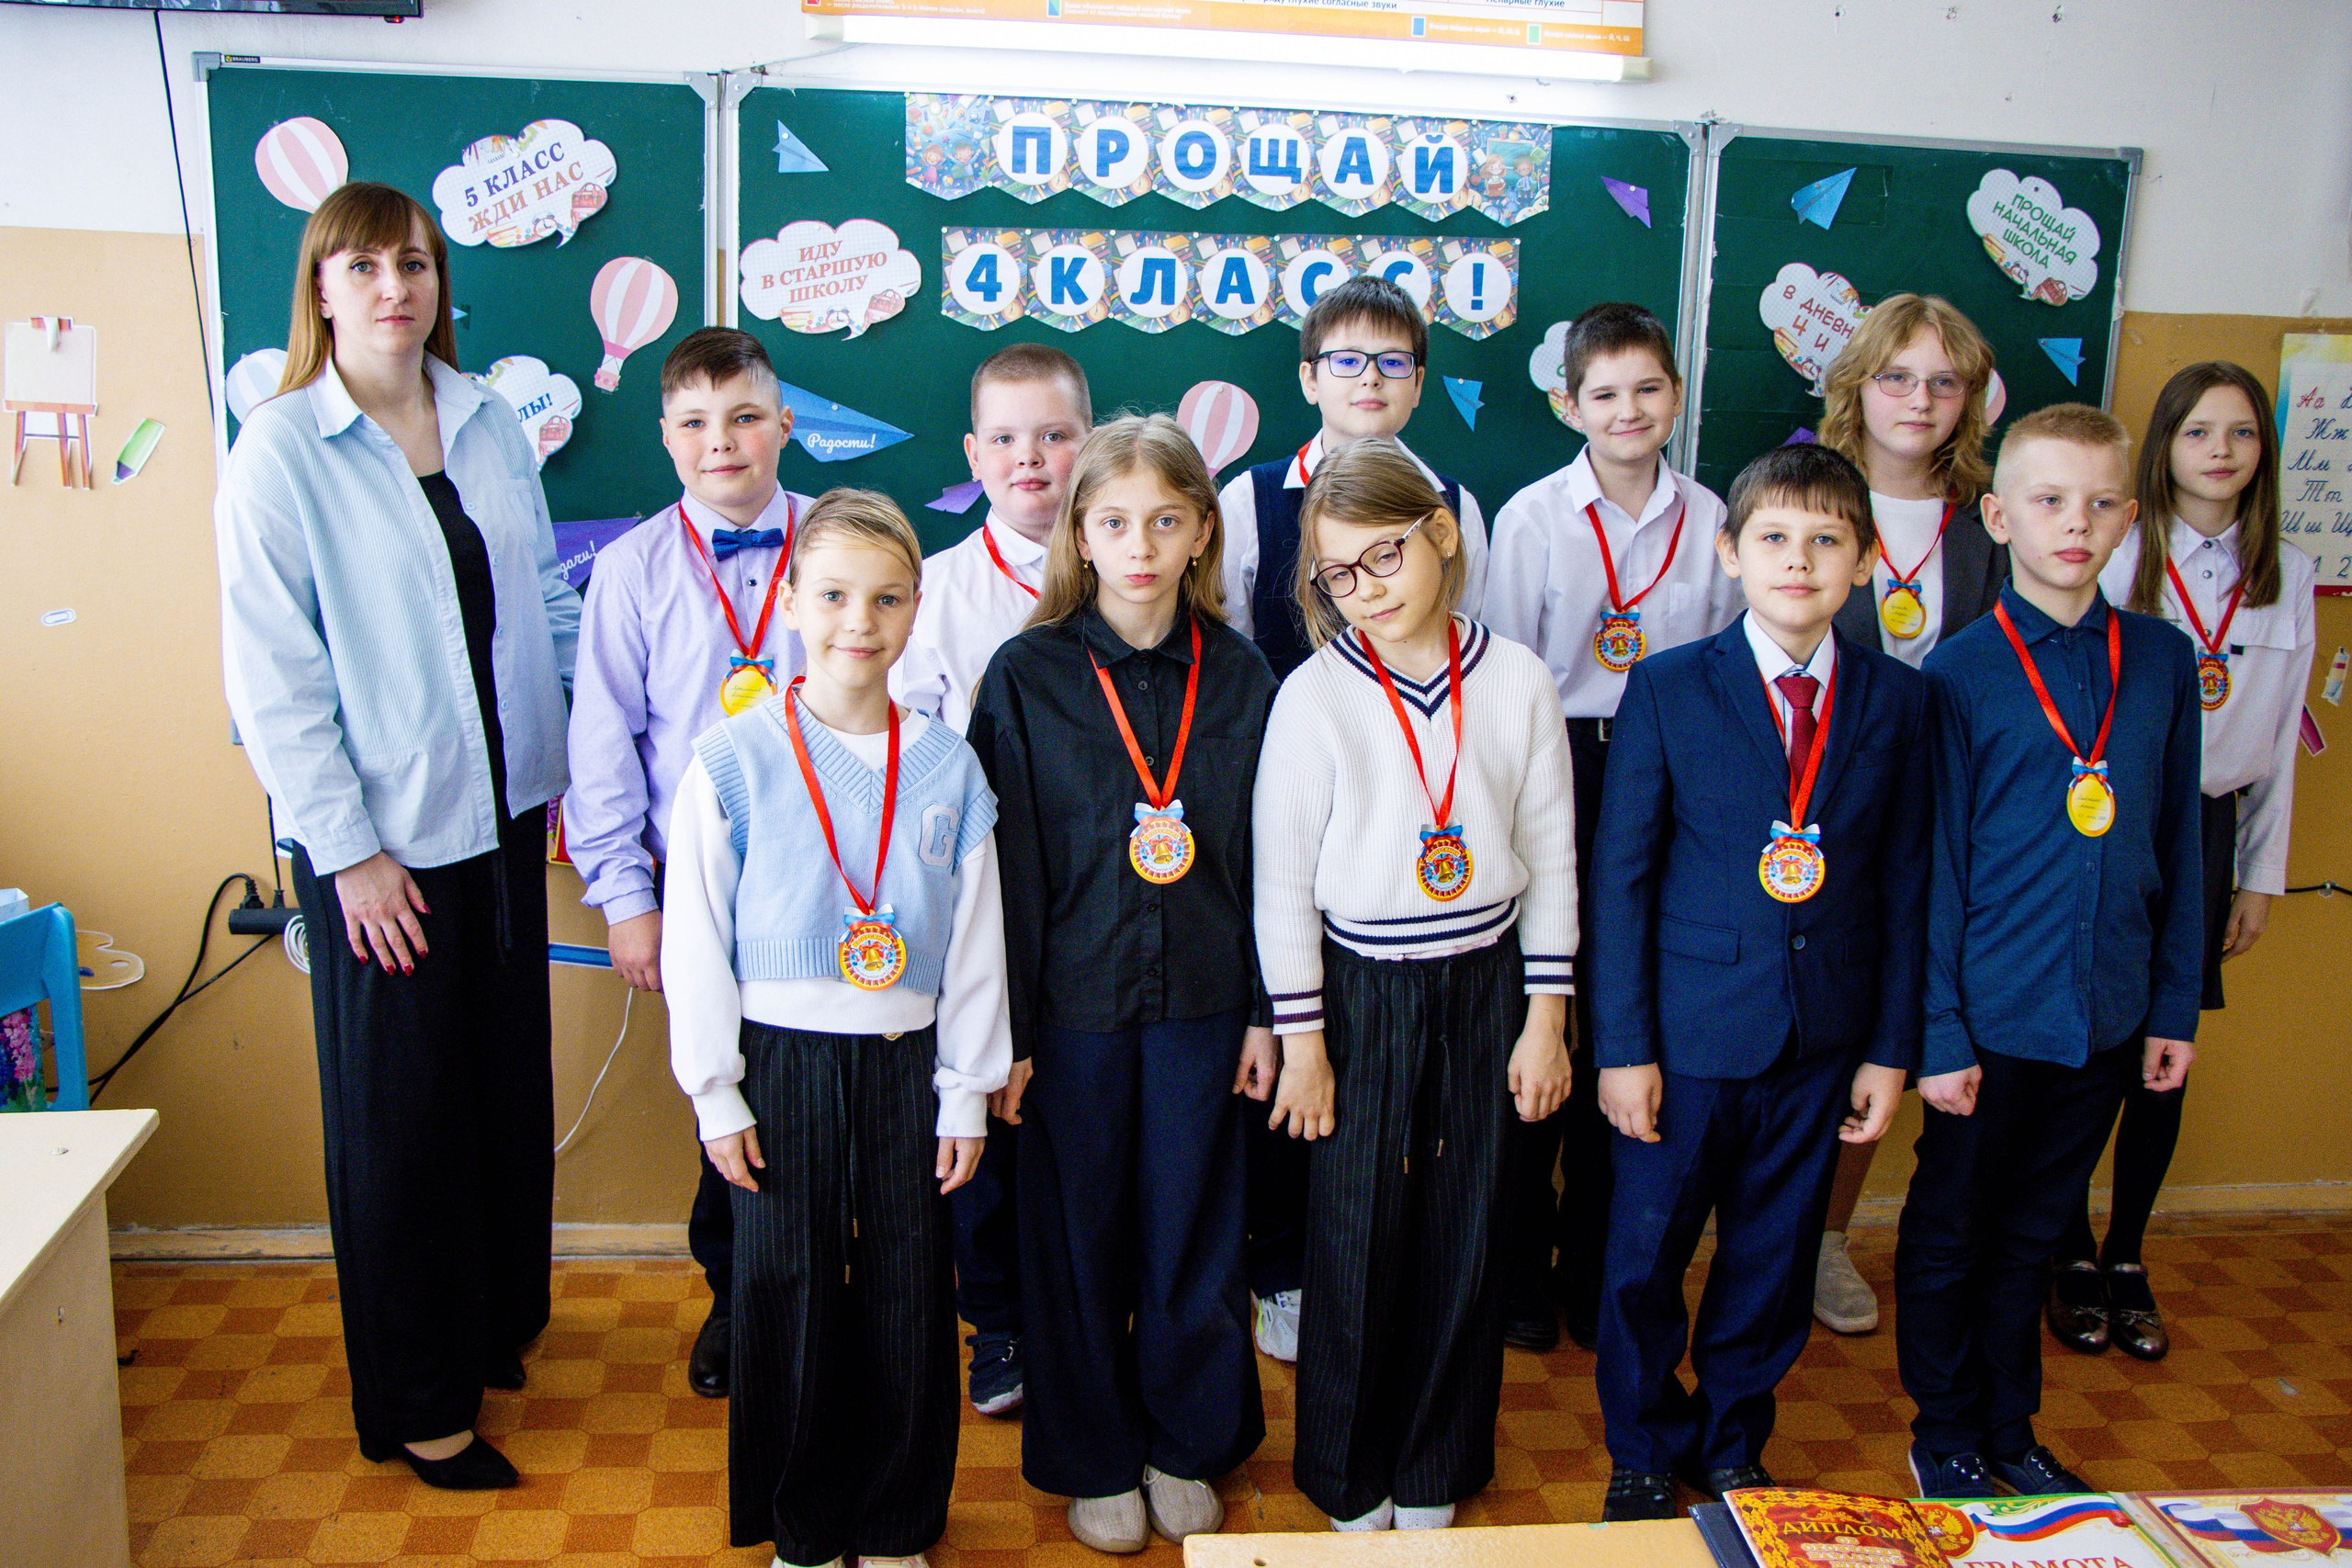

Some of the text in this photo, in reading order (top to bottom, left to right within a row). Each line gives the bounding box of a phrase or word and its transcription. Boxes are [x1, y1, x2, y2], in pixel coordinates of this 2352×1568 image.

[1372, 1, 1397, 10] звуки
[464, 141, 565, 207] 5 КЛАСС
[1012, 126, 1453, 194] ПРОЩАЙ
[469, 161, 584, 233] ЖДИ НАС
[1993, 201, 2077, 265] НАЧАЛЬНАЯ
[2011, 193, 2076, 243] ПРОЩАЙ
[798, 240, 843, 263] ИДУ
[2002, 229, 2049, 269] ШКОЛА
[761, 252, 888, 290] В СТАРШУЮ
[788, 275, 869, 304] ШКОЛУ
[965, 254, 1002, 303] 4
[1782, 284, 1796, 299] В
[1799, 298, 1855, 339] ДНЕВН
[517, 392, 553, 423] ЛЫ!
[2296, 387, 2325, 409] Аа
[808, 433, 876, 454] Радости!
[560, 540, 597, 581] дачи!
[2312, 556, 2352, 578] 1 2
[1782, 1521, 1905, 1540] ДИПЛОМ
